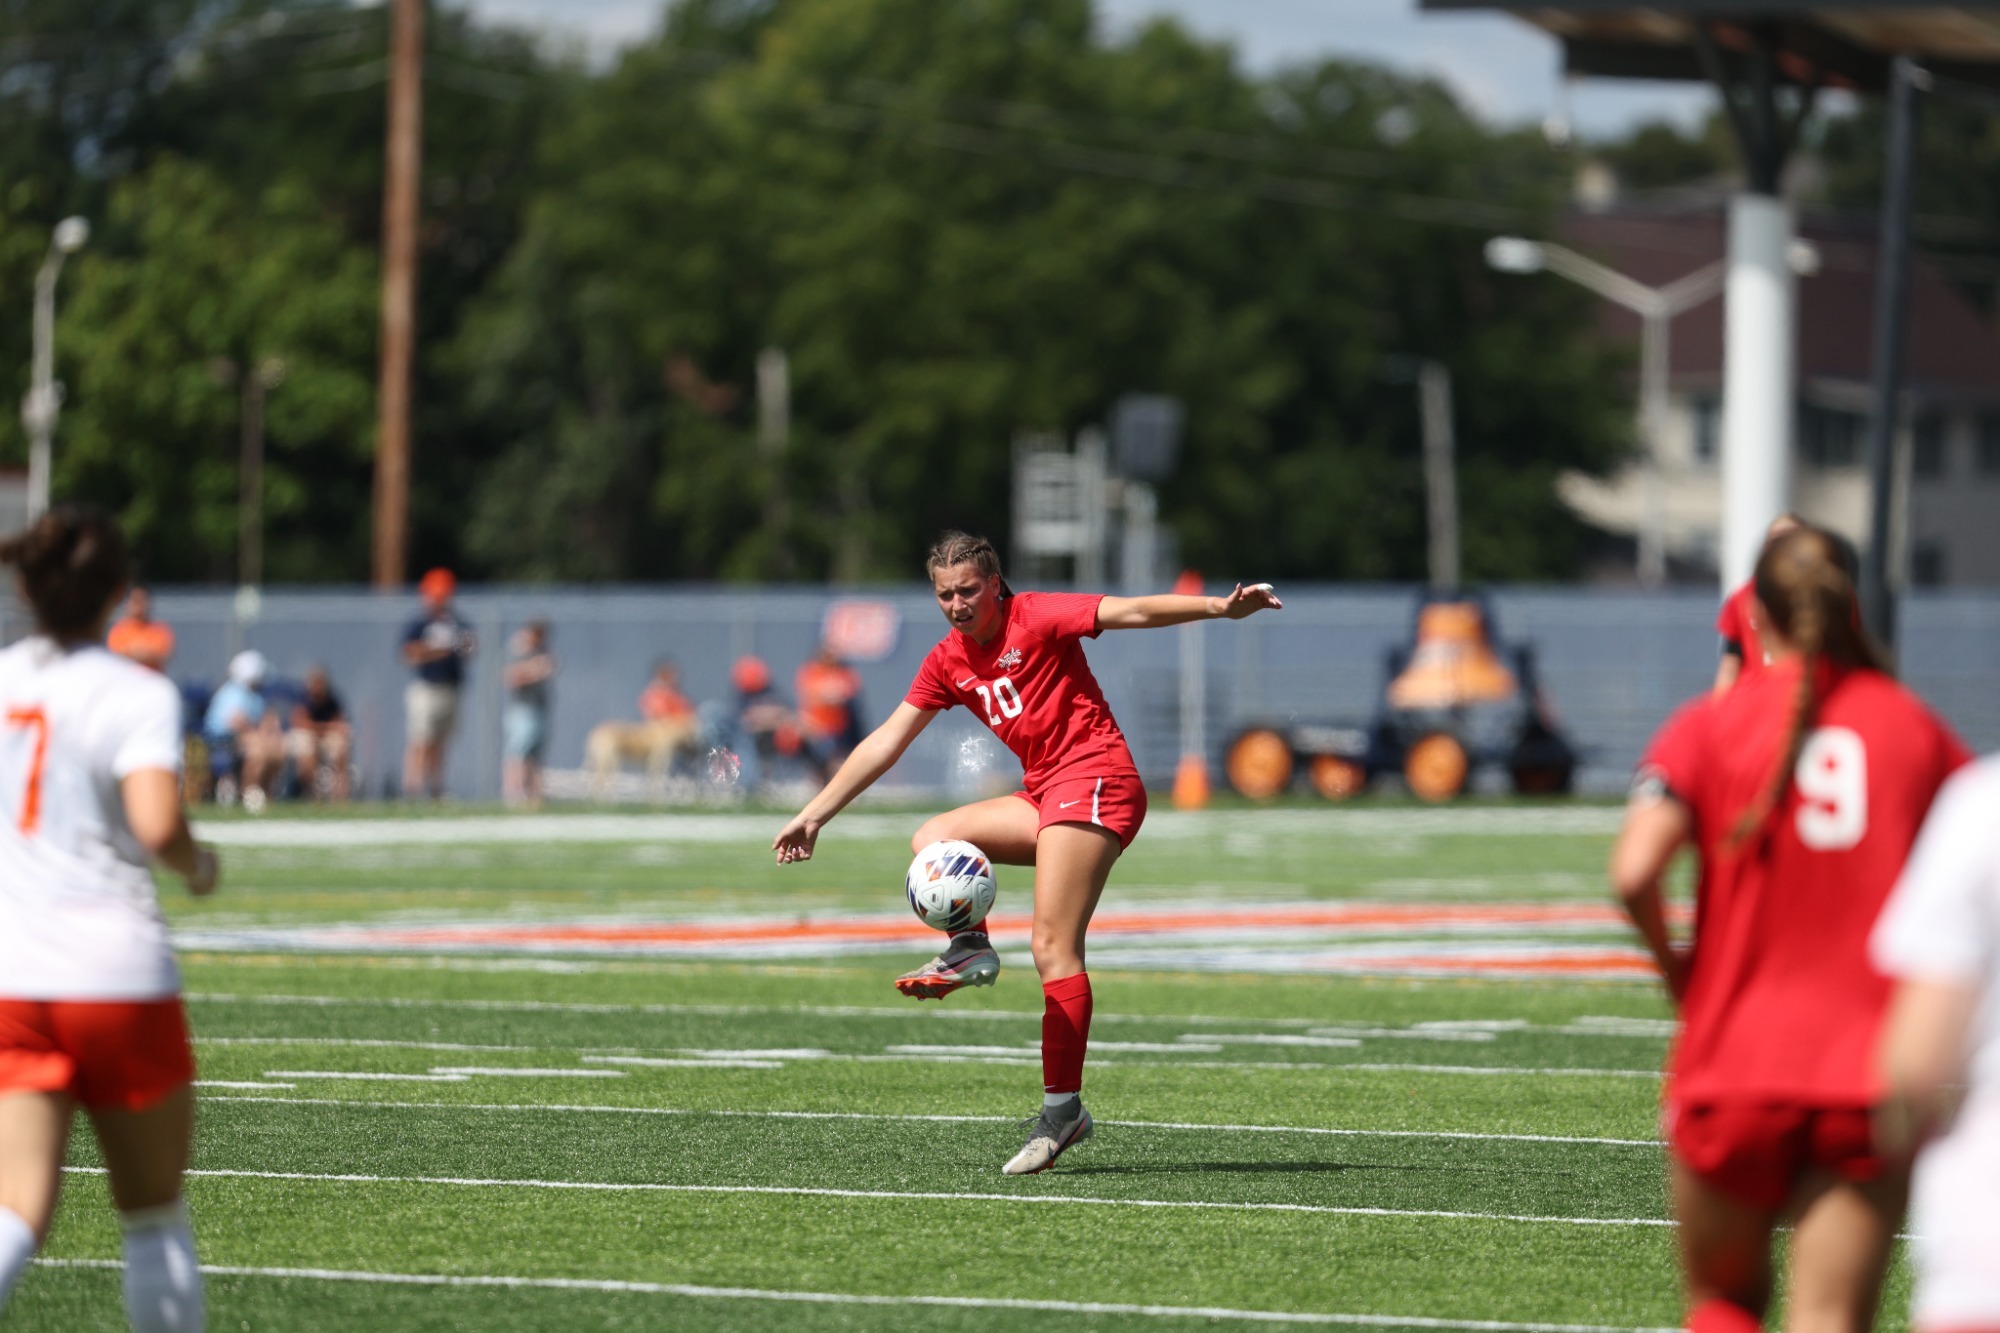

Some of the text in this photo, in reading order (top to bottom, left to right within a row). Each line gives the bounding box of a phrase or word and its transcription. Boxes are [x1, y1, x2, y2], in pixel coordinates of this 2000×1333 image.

[976, 677, 1023, 725] 20
[7, 705, 50, 834] 7
[1795, 727, 1867, 851] 9
